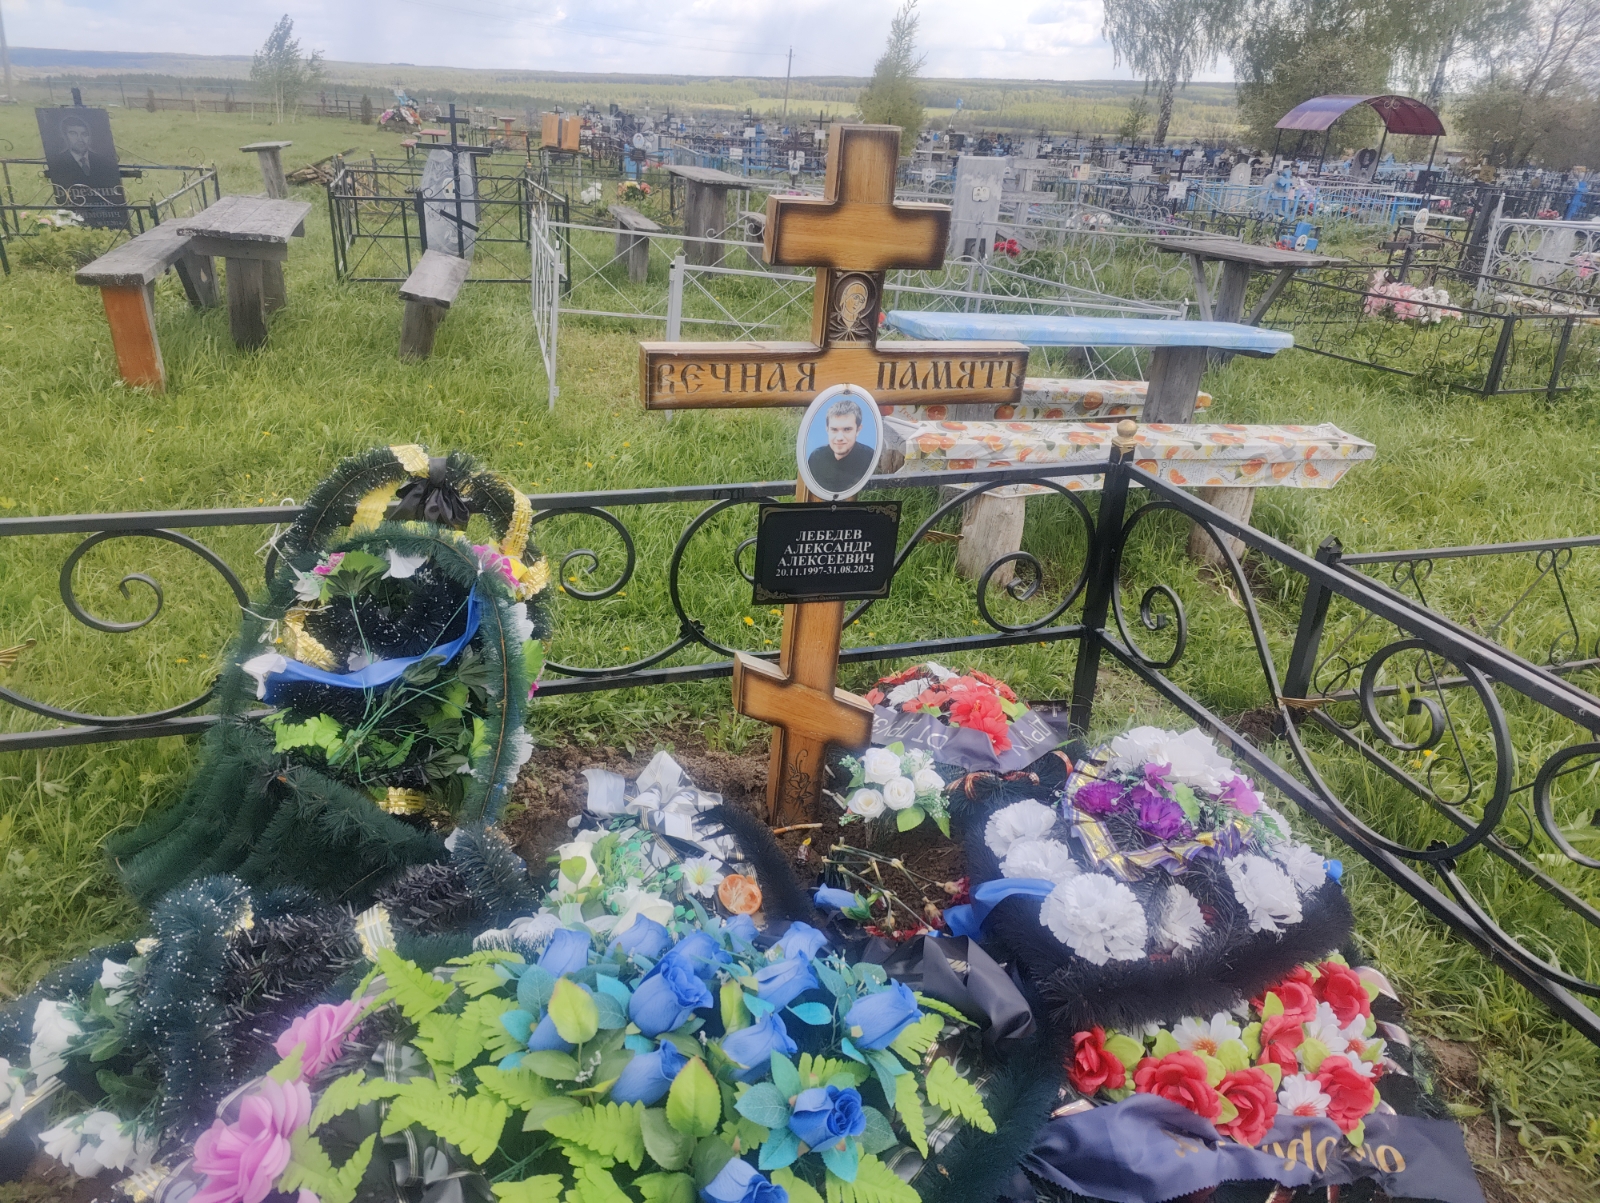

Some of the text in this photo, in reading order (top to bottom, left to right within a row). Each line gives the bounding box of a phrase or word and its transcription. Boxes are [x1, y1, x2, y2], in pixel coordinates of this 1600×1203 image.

[655, 360, 1022, 395] ВЕЧНАЯ ПАМЯТЬ
[795, 529, 863, 542] ЛЕБЕДЕВ
[783, 541, 872, 555] АЛЕКСАНДР
[777, 553, 875, 567] АЛЕКСЕЕВИЧ
[775, 565, 875, 577] 20.11.1997-31.08.2023
[872, 713, 922, 738] ДРУЗ
[911, 724, 949, 750] ОТ
